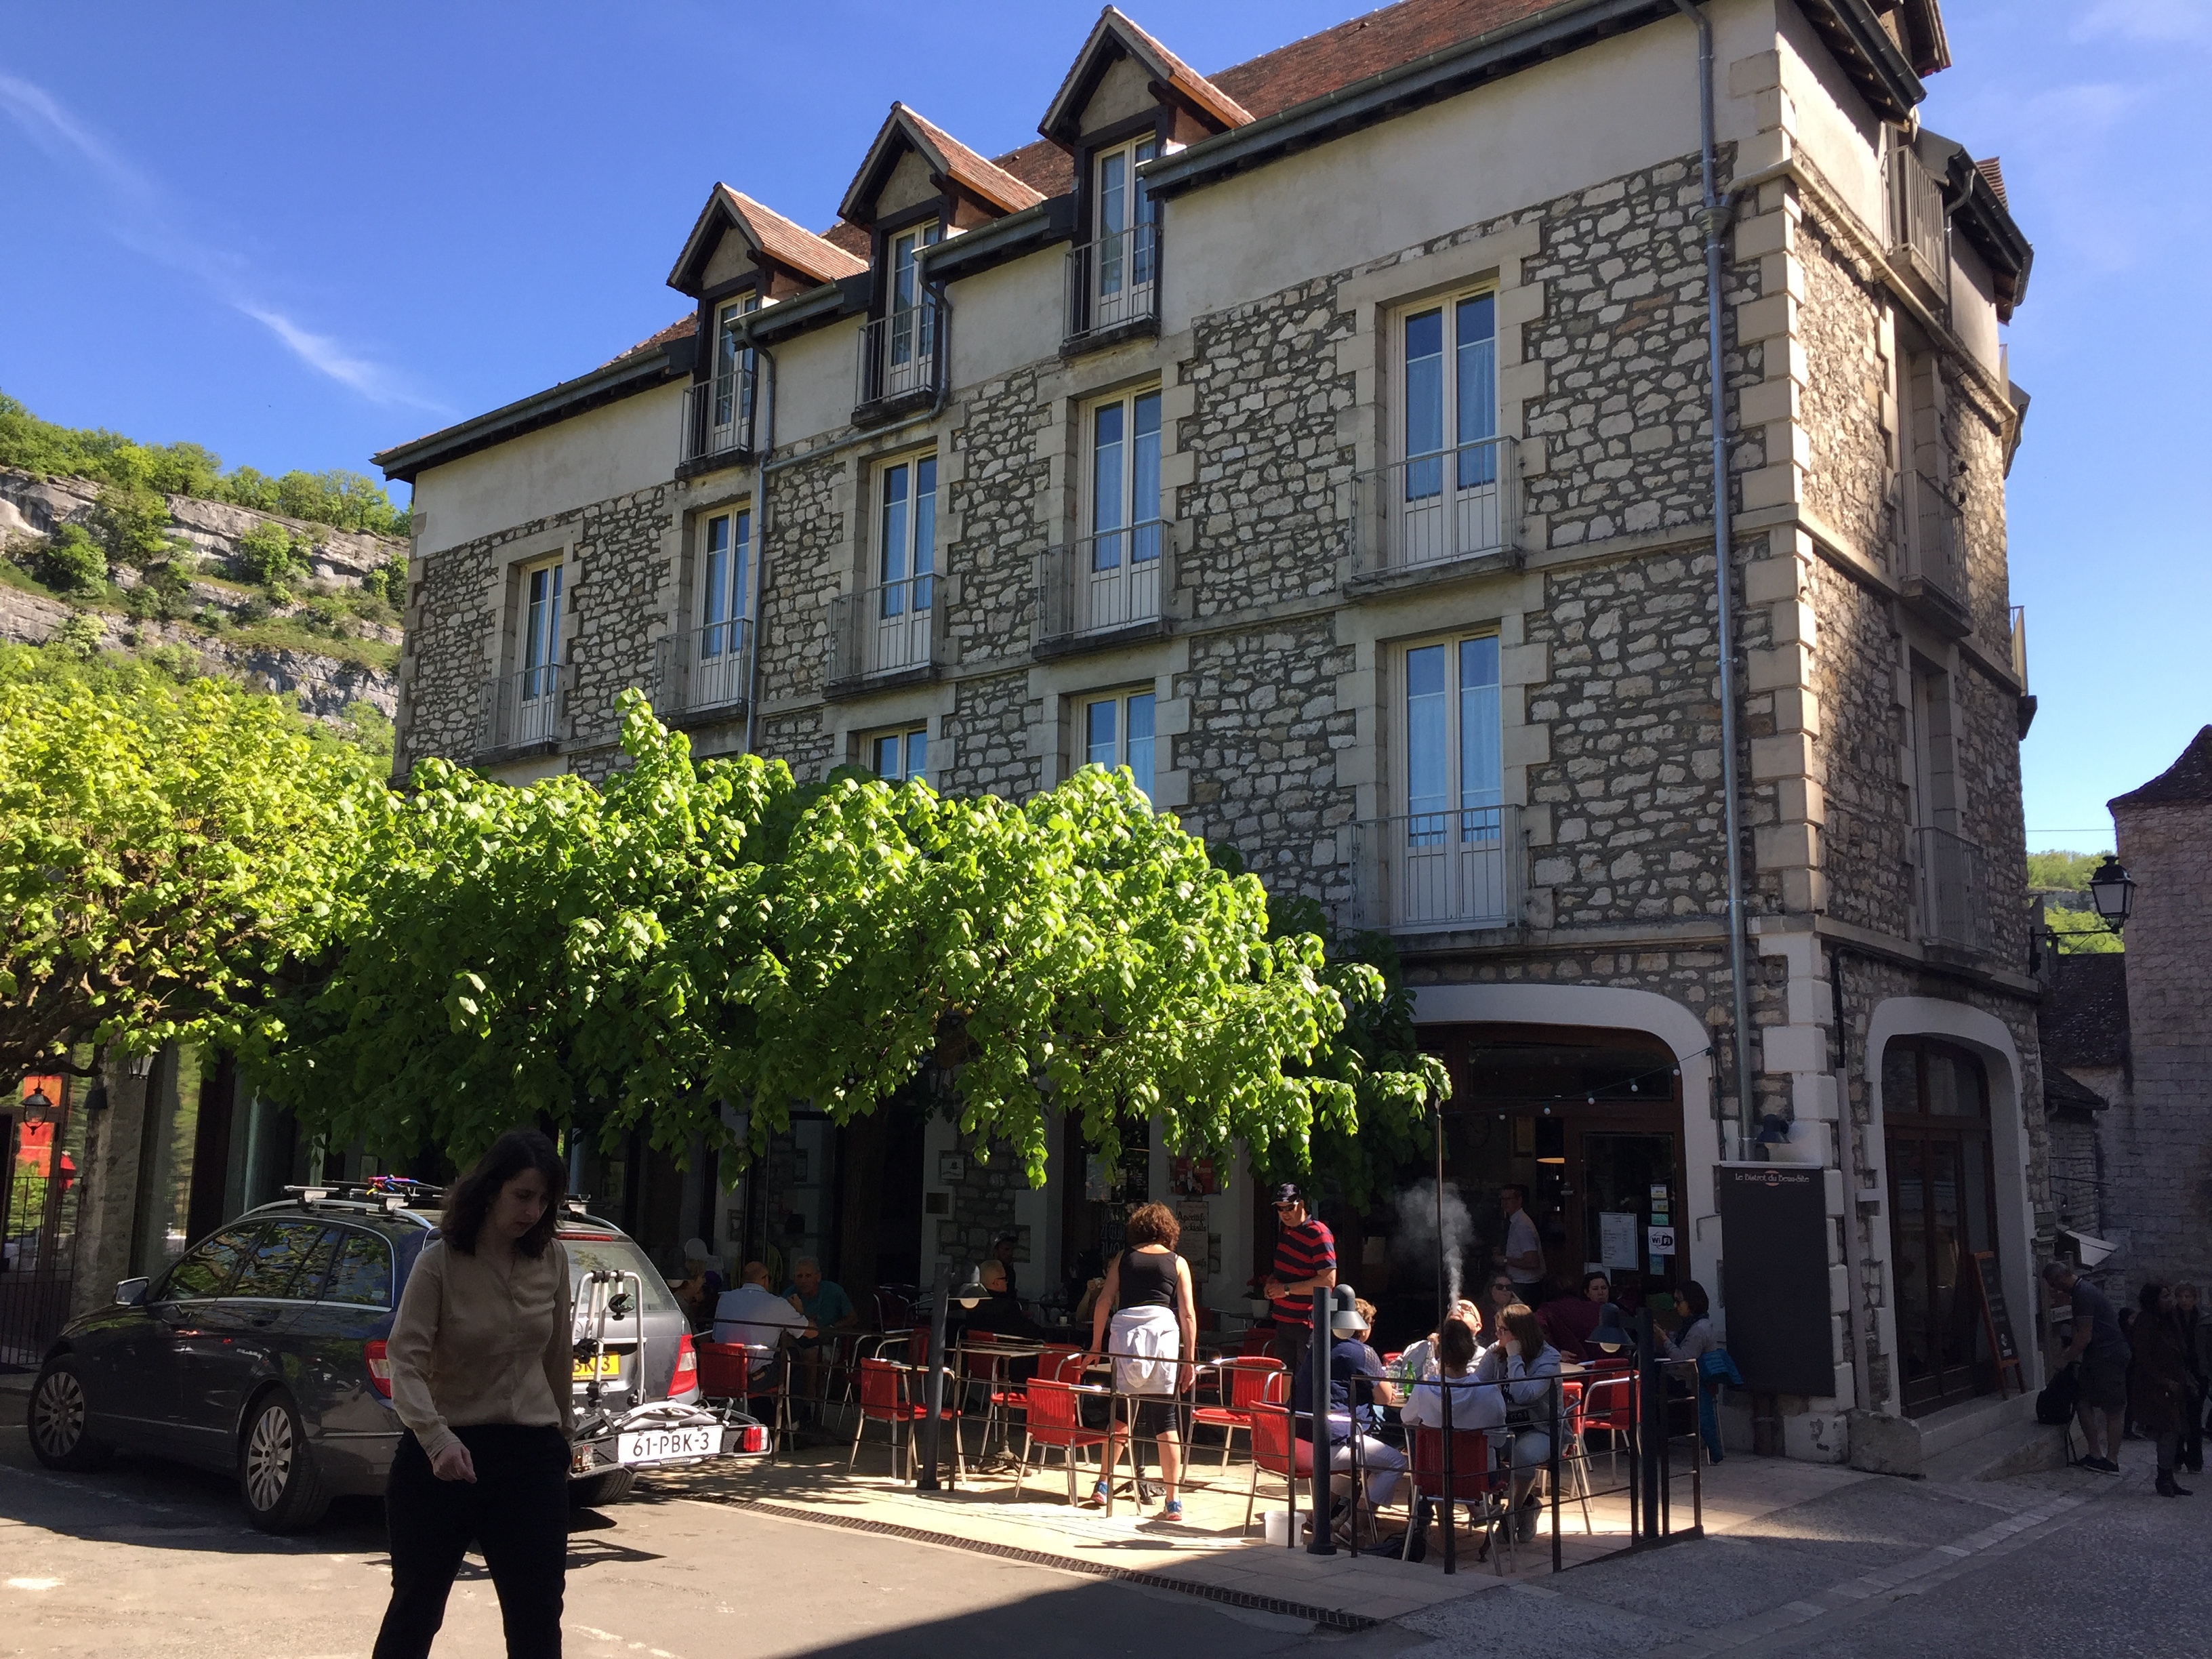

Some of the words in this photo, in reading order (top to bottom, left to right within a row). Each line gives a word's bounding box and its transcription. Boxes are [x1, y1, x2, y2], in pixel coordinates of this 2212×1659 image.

[1735, 1172, 1744, 1181] Le
[1744, 1172, 1767, 1182] Bistrot
[1767, 1174, 1778, 1182] du
[1183, 1222, 1207, 1232] ocktails
[633, 1432, 710, 1457] 61-PBK-3
